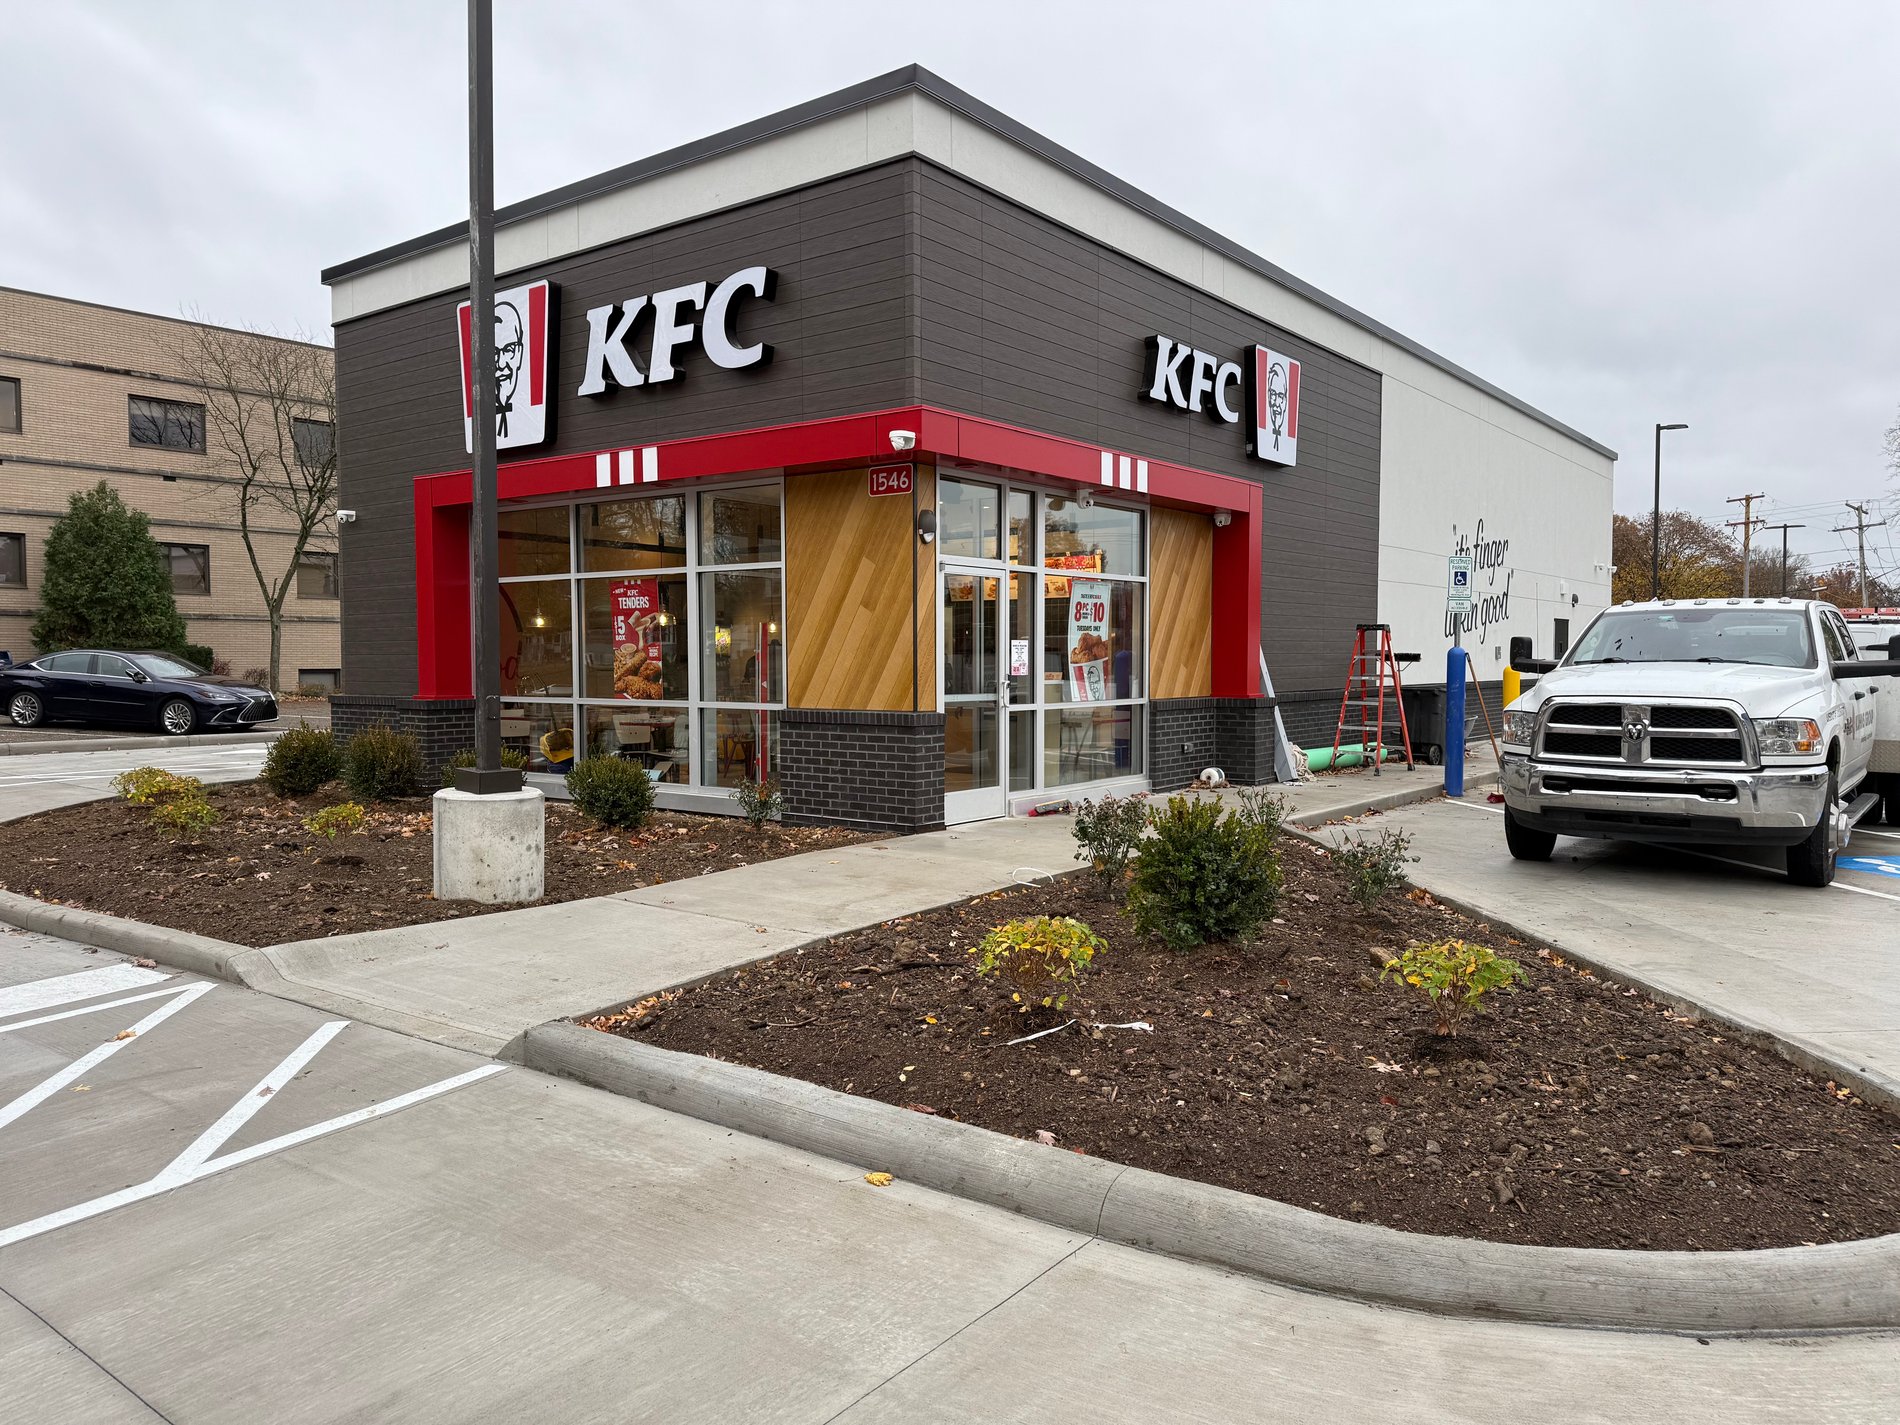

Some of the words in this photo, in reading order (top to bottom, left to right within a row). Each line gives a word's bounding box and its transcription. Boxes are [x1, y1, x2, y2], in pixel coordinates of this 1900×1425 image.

[577, 265, 770, 397] KFC
[1148, 334, 1242, 424] KFC
[872, 470, 909, 492] 1546
[1473, 518, 1509, 586] finger
[618, 596, 649, 609] TENDERS
[1074, 601, 1082, 622] 8
